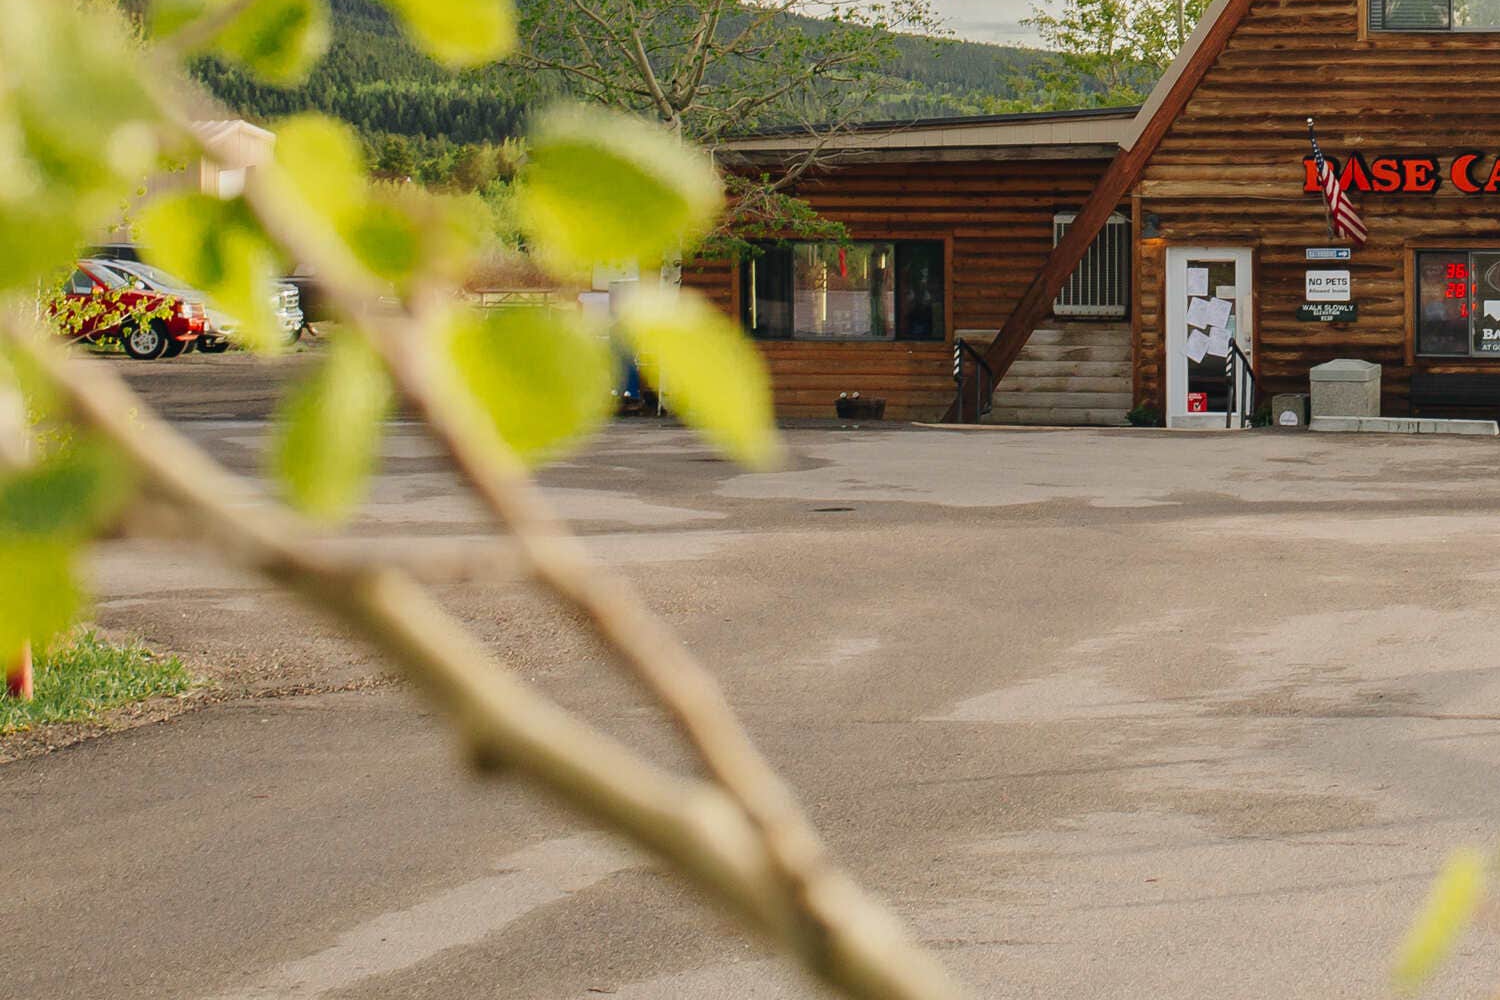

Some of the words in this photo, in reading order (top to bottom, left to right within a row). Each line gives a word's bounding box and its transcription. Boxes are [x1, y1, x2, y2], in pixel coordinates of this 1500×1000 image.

[1303, 155, 1436, 192] BASE
[1308, 278, 1322, 286] NO
[1326, 278, 1348, 286] PETS
[1302, 304, 1322, 312] WALK
[1324, 304, 1354, 312] SLOWLY
